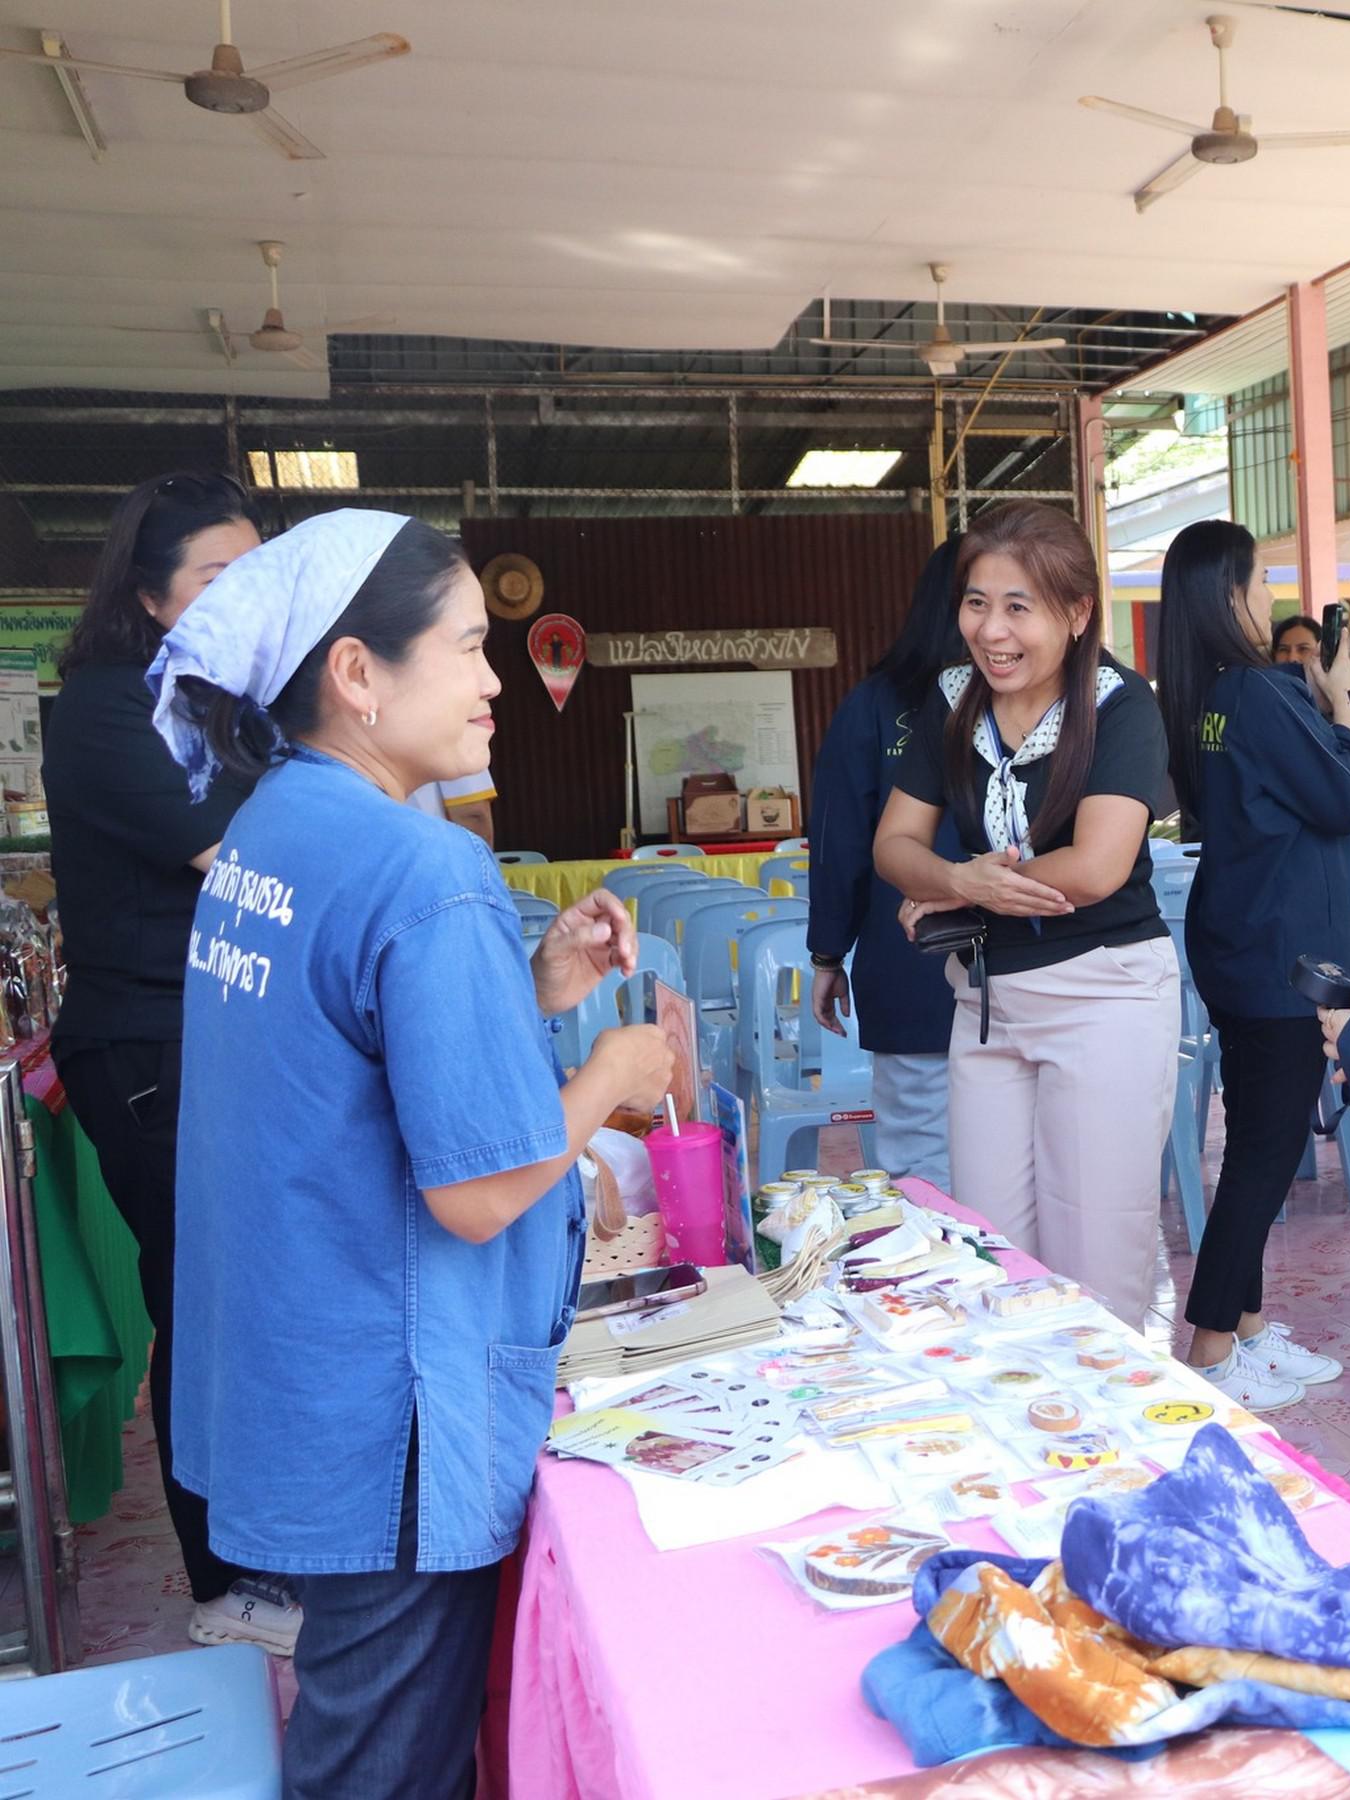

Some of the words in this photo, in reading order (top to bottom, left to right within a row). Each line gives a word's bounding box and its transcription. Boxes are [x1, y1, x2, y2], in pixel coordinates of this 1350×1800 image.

[608, 628, 811, 665] แปลงใหญ่กล้วยไข่
